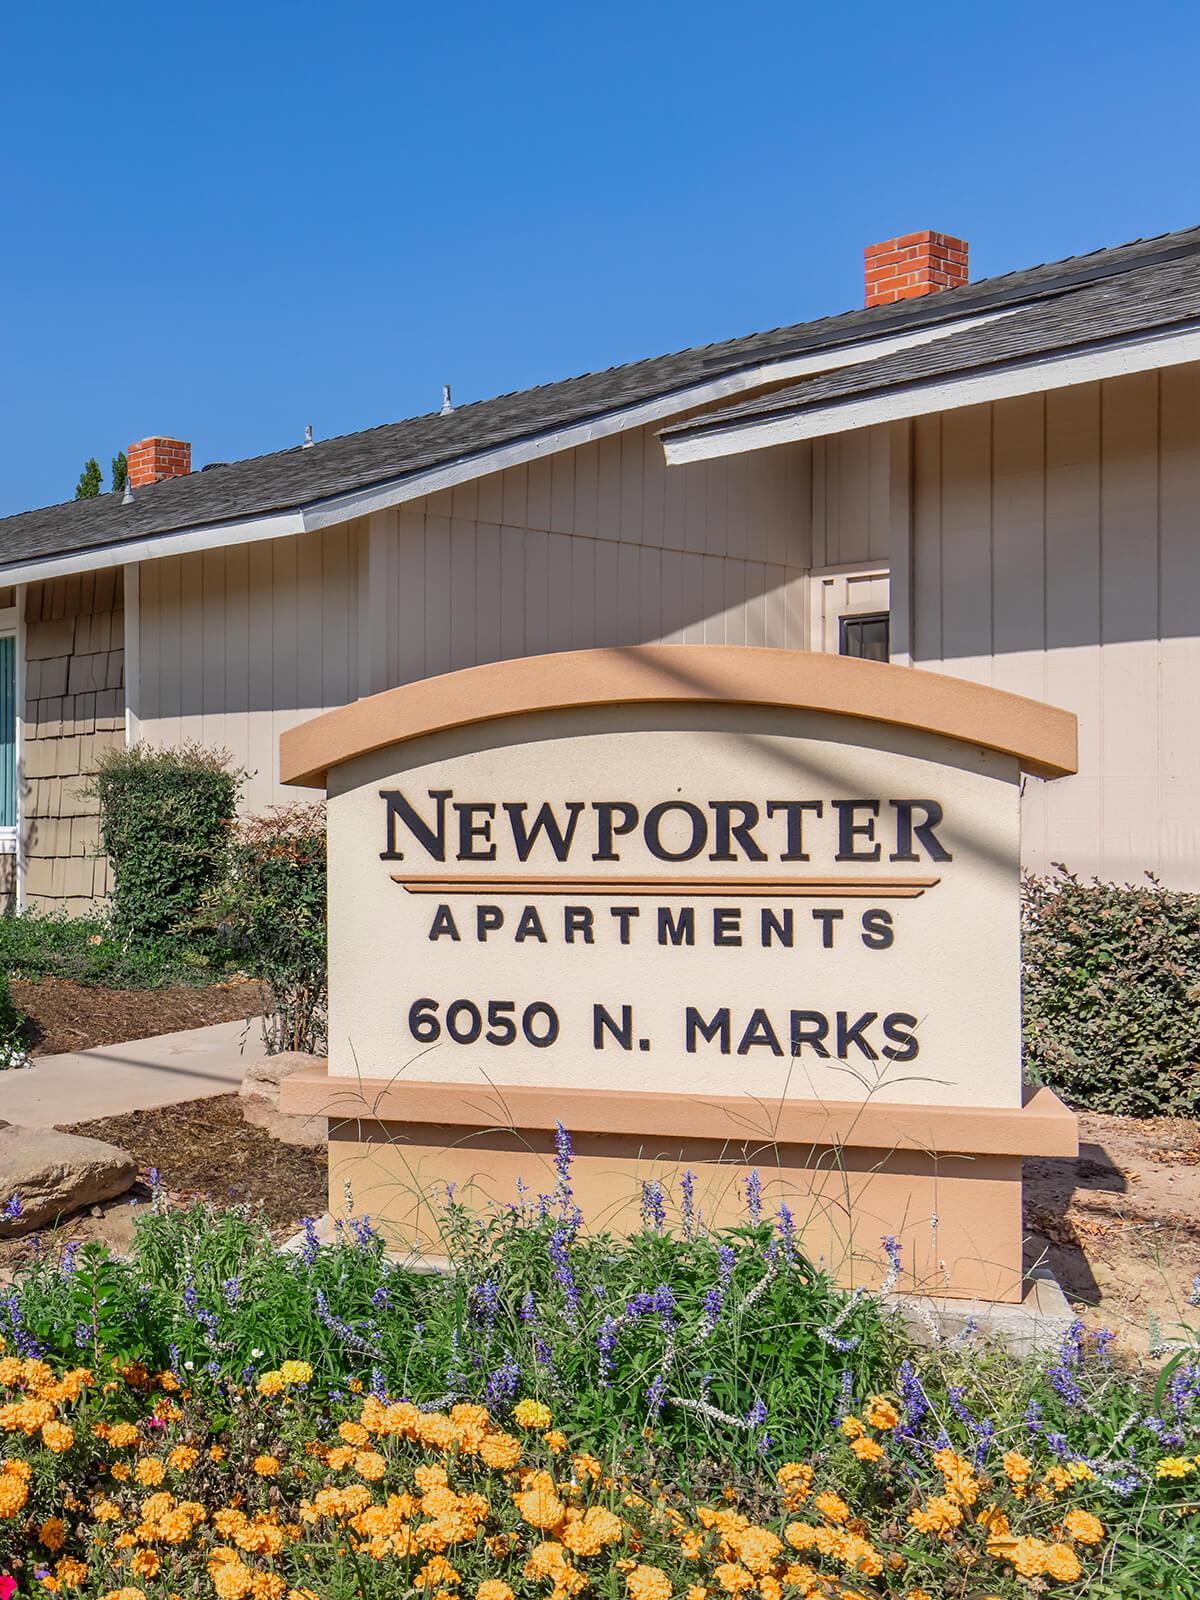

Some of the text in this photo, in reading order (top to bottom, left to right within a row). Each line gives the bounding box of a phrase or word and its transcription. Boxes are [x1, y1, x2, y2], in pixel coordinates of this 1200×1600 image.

[378, 789, 953, 863] NEWPORTER
[428, 904, 894, 950] APARTMENTS
[408, 998, 919, 1062] 6050 N. MARKS
